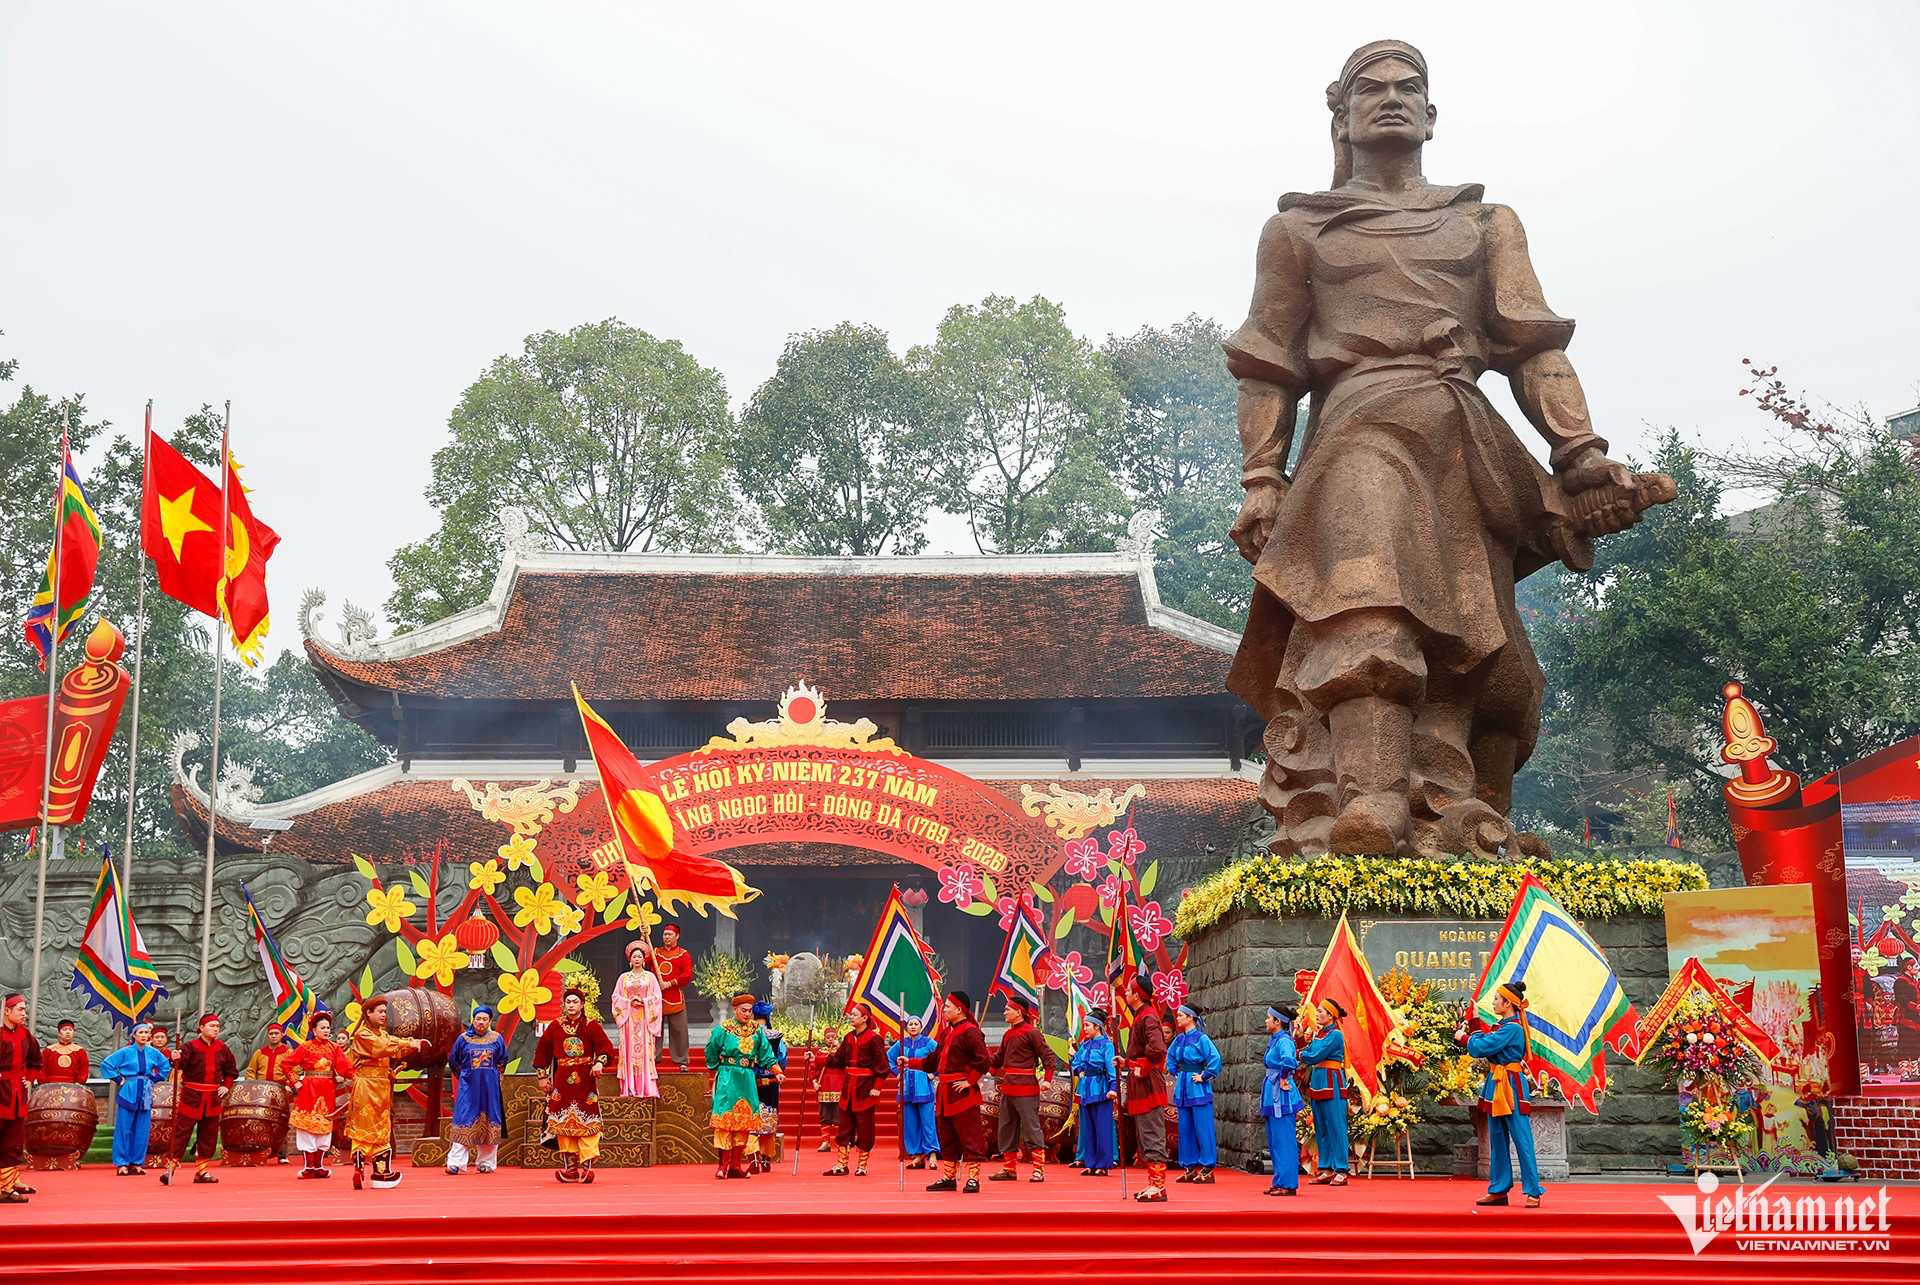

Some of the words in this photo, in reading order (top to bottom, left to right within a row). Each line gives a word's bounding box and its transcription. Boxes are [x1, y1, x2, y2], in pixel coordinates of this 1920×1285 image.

[660, 772, 690, 803] LỄ
[692, 767, 732, 793] HỘI
[736, 758, 765, 785] KỶ
[772, 758, 833, 785] NIỆM
[838, 765, 880, 790] 237
[882, 775, 938, 808] NĂM
[717, 794, 767, 821] NGỌC
[773, 788, 804, 814] HỒI
[822, 792, 873, 821] ĐỐNG
[876, 804, 902, 829] ĐA
[906, 814, 950, 845] (1789
[960, 837, 1007, 873] 2026)
[1439, 927, 1487, 943] HOÀNG
[1489, 928, 1503, 943] Đ
[1395, 951, 1473, 972] QUANG
[1425, 973, 1480, 993] NGUYỄ
